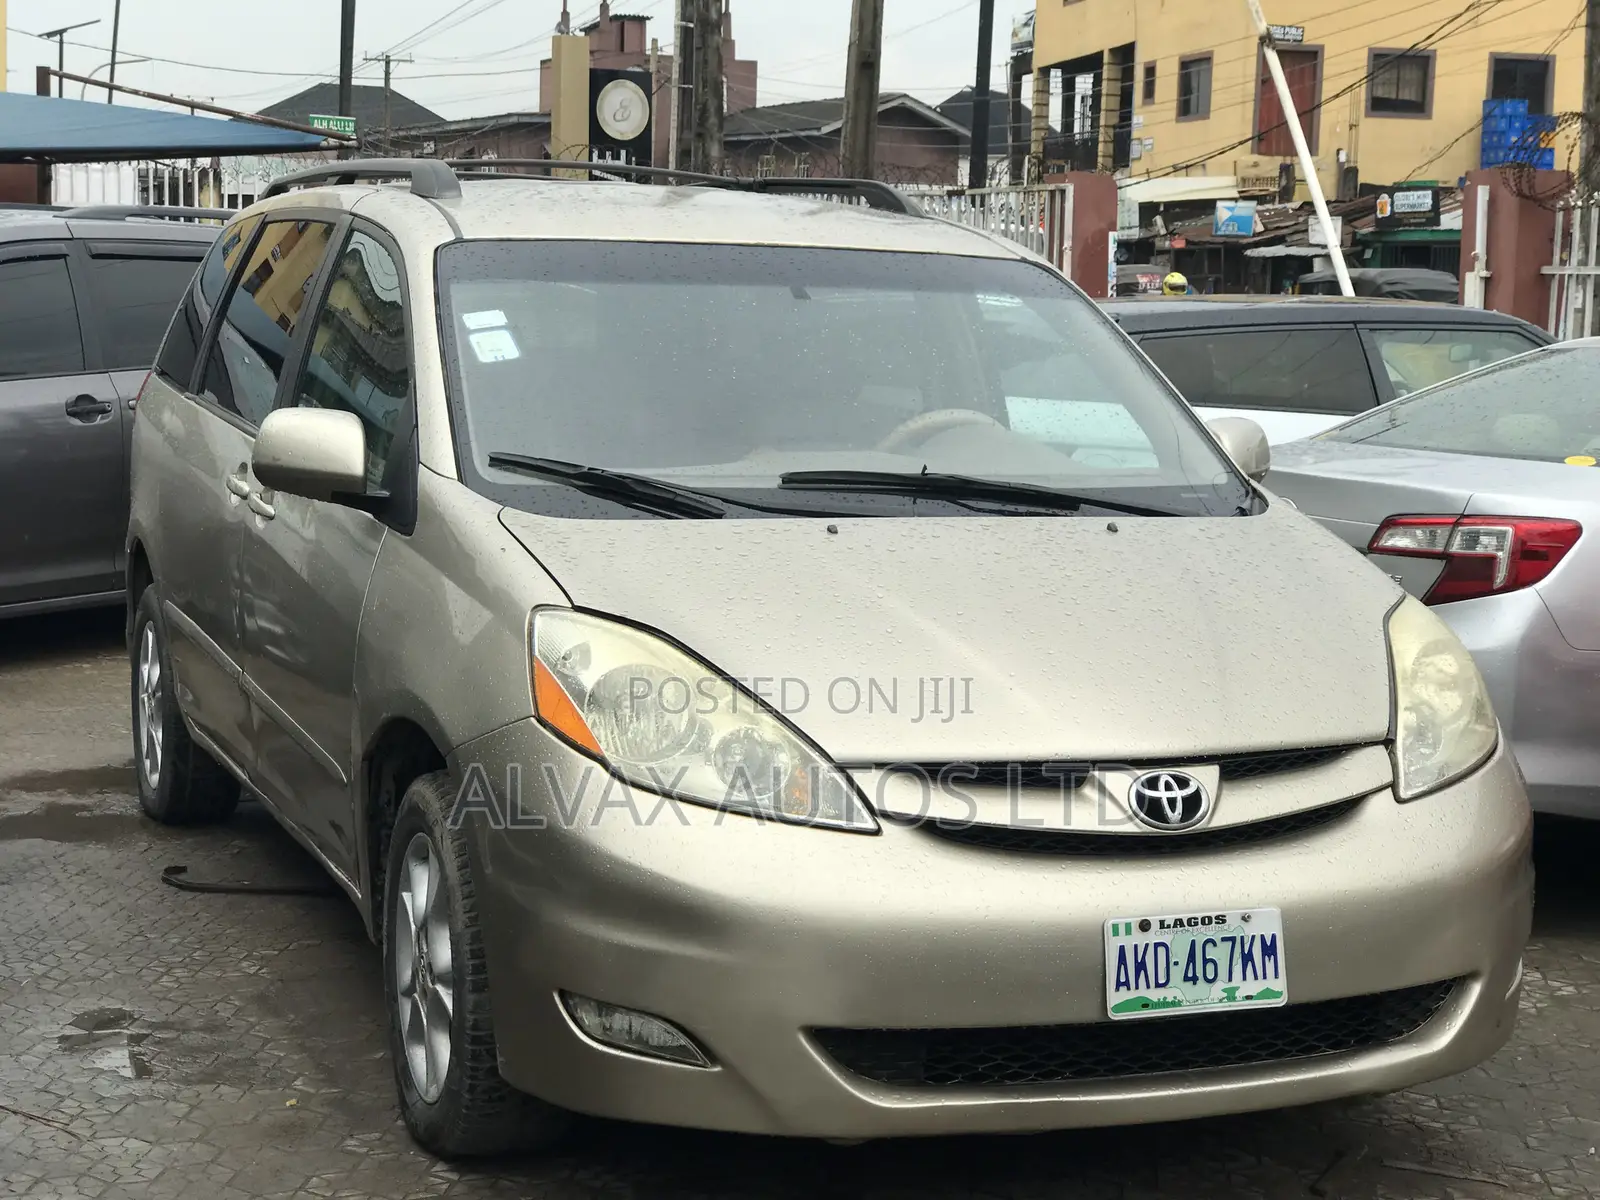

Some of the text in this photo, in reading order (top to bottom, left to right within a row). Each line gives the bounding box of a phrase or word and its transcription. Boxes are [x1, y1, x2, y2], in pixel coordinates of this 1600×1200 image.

[313, 119, 328, 129] ALH
[1158, 914, 1228, 930] LAGOS
[1154, 928, 1182, 937] CENTRE
[1191, 923, 1232, 934] EXCELLENCE
[1115, 932, 1280, 993] AKD-467KM
